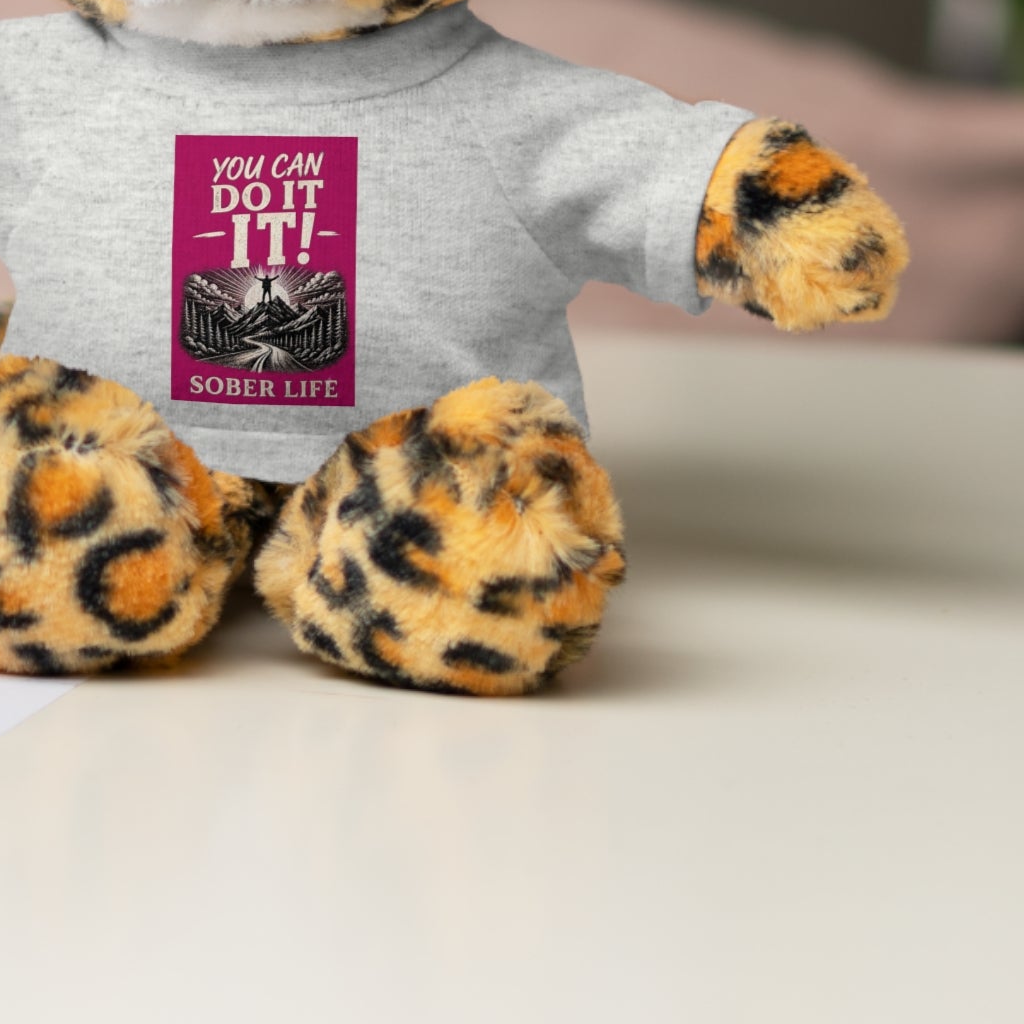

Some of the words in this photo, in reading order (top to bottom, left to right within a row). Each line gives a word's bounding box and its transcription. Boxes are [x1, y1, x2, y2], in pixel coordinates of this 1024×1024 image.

[212, 154, 265, 183] YOU
[271, 152, 325, 178] CAN
[210, 182, 272, 214] DO
[282, 179, 324, 210] IT
[230, 211, 316, 269] IT!
[189, 375, 275, 398] SOBER
[283, 379, 339, 398] LIFE
